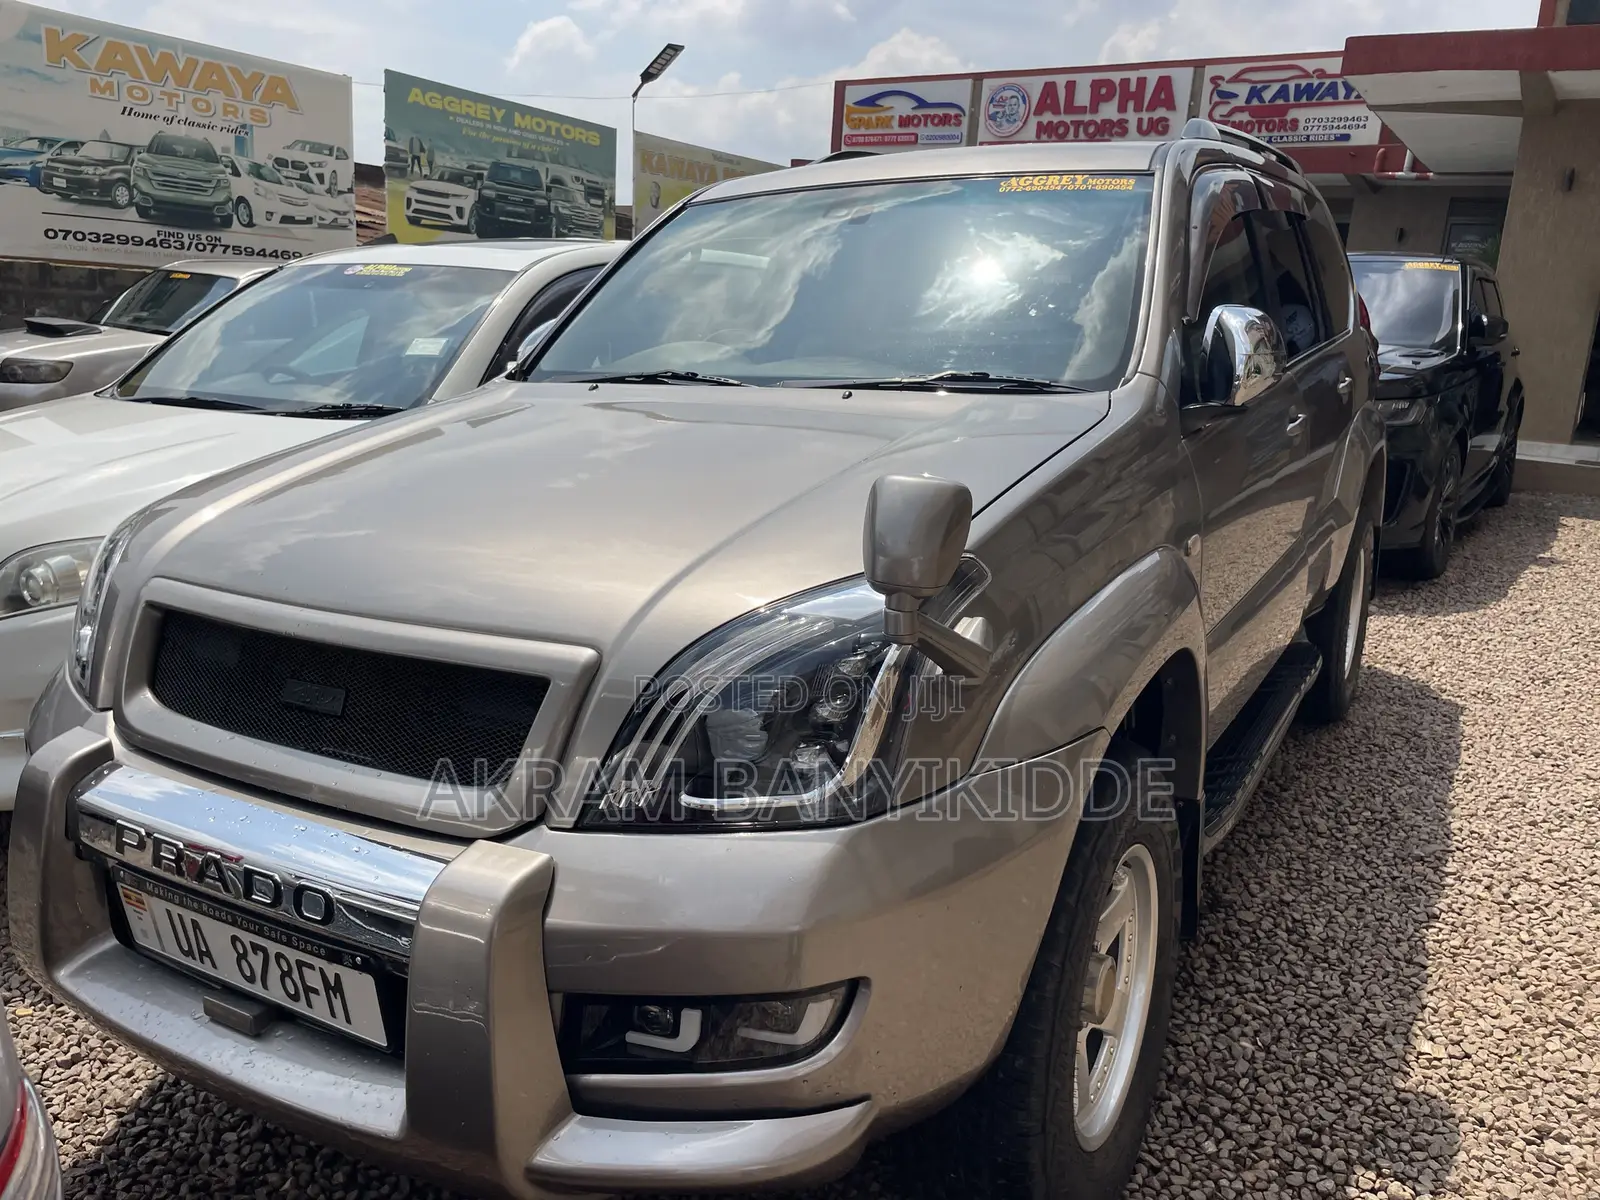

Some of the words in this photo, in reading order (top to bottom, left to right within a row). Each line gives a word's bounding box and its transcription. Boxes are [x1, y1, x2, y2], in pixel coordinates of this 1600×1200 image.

[43, 26, 302, 113] KAWAYA
[88, 77, 271, 126] MOTORS
[1033, 75, 1177, 116] ALPHA
[120, 106, 160, 121] Home
[163, 114, 181, 126] of
[177, 117, 218, 132] classic
[219, 124, 250, 137] rides
[408, 88, 506, 122] AGGREY
[514, 112, 601, 146] MOTORS
[898, 113, 963, 128] MOTORS
[1035, 118, 1129, 140] MOTORS
[1136, 117, 1171, 137] UG
[1303, 124, 1367, 132] 0775944694
[1304, 116, 1369, 124] 0703299463
[1271, 134, 1308, 143] CLASSIC
[640, 149, 718, 184] KAWAYA
[1001, 175, 1088, 187] AGGREY
[1087, 178, 1135, 186] MOTORS
[43, 228, 313, 260] 0703299463/077594469
[156, 230, 184, 239] FIND
[188, 233, 202, 241] US
[206, 235, 222, 243] ON
[115, 819, 337, 926] PRADO
[146, 882, 180, 903] Making
[183, 895, 199, 910] the
[237, 915, 261, 933] Your
[263, 926, 288, 943] Safe
[291, 936, 326, 957] Space
[165, 907, 218, 970] UA
[230, 934, 352, 1025] 878FM
